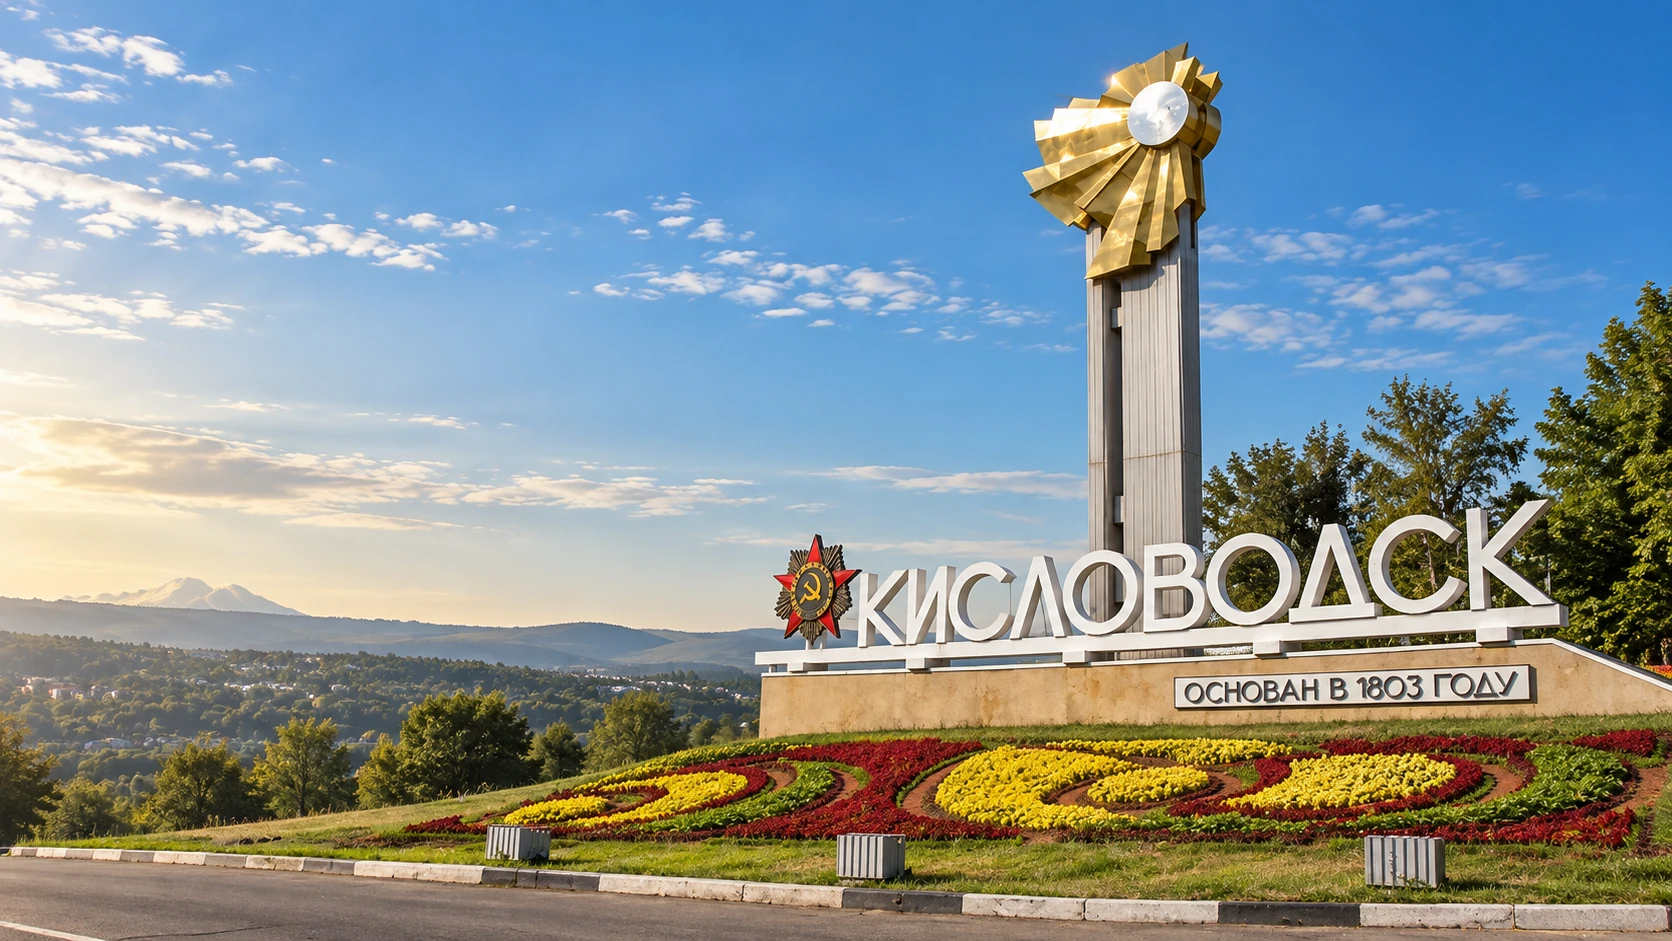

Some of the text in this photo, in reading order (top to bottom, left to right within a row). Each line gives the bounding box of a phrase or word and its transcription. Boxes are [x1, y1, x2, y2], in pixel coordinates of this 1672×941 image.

[858, 498, 1555, 648] КИСЛОВОДСК
[1184, 671, 1519, 704] ОСНОВАН В 1803 ГОДУ
